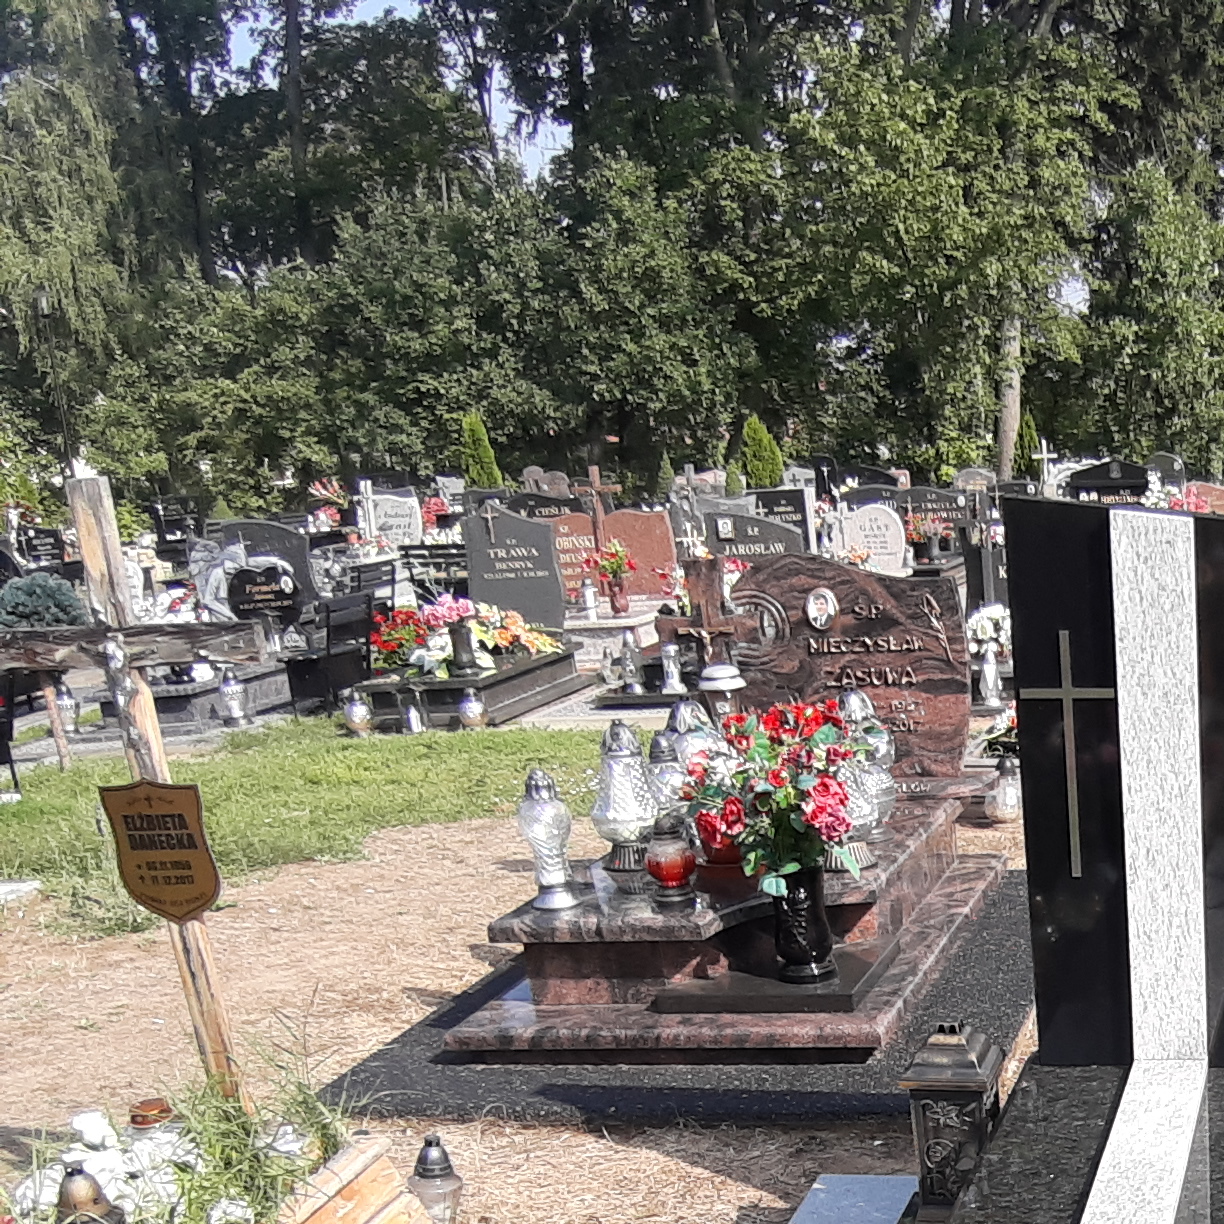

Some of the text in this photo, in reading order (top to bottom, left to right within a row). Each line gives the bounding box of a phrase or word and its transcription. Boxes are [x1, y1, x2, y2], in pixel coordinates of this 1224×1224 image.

[555, 534, 596, 550] OBIŃSKI
[487, 546, 540, 560] TRAWA
[807, 634, 926, 654] MIECZYSŁAW
[822, 665, 918, 688] ZASUWA
[120, 812, 190, 832] ELŻBIETA
[126, 832, 199, 851] DANECKA
